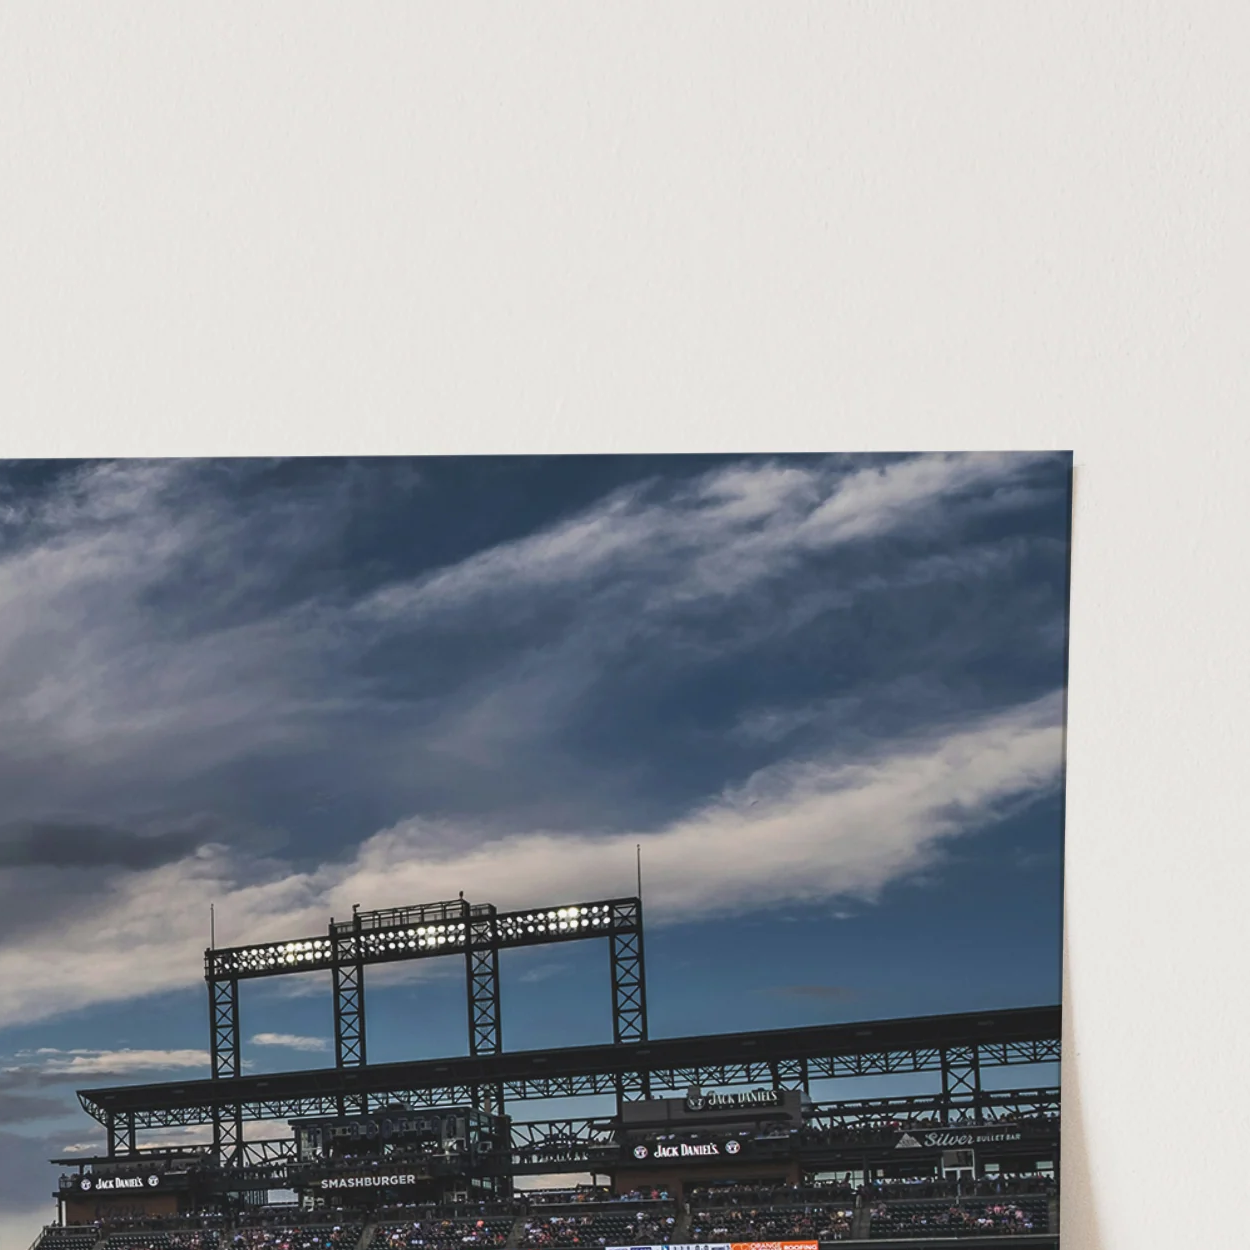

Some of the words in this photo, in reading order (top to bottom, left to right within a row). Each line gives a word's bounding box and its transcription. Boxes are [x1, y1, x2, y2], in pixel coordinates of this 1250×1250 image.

[924, 1132, 974, 1146] Silver
[976, 1134, 1004, 1142] BULLET
[1005, 1133, 1021, 1141] BAR
[654, 1144, 679, 1158] JACK
[680, 1142, 719, 1157] DANIEL'S
[95, 1178, 114, 1190] JACK
[115, 1177, 144, 1189] DANIEL'S
[321, 1174, 416, 1189] SMASHBURGER
[750, 1242, 782, 1250] ORANGE
